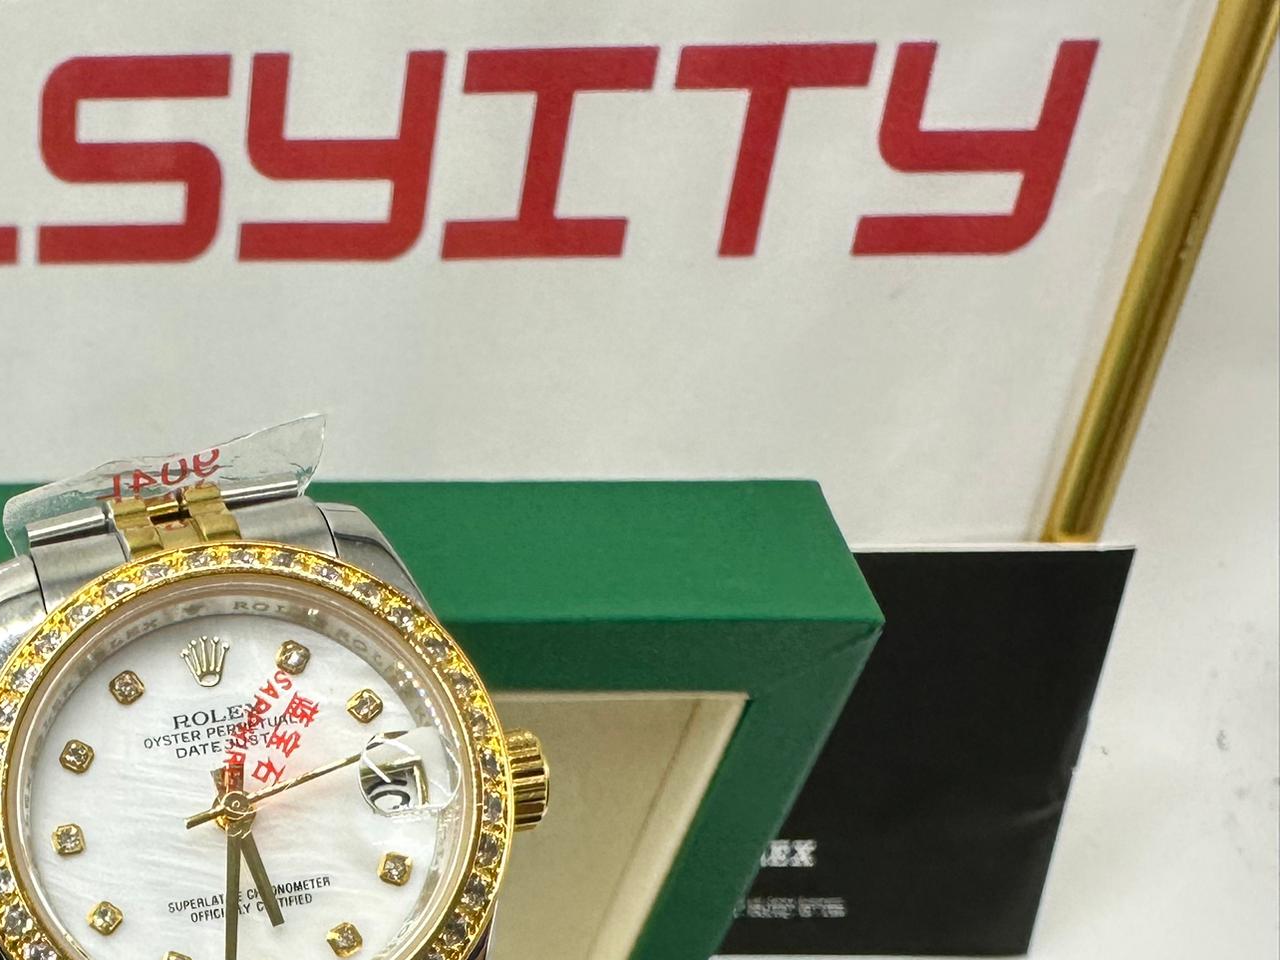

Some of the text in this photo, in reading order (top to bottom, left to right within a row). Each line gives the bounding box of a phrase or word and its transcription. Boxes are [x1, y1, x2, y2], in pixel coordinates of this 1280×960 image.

[144, 731, 201, 749] OYSTER
[168, 876, 331, 913] SUPERLATE CHONOMETER
[191, 893, 313, 923] OFFICILY CTIFIED
